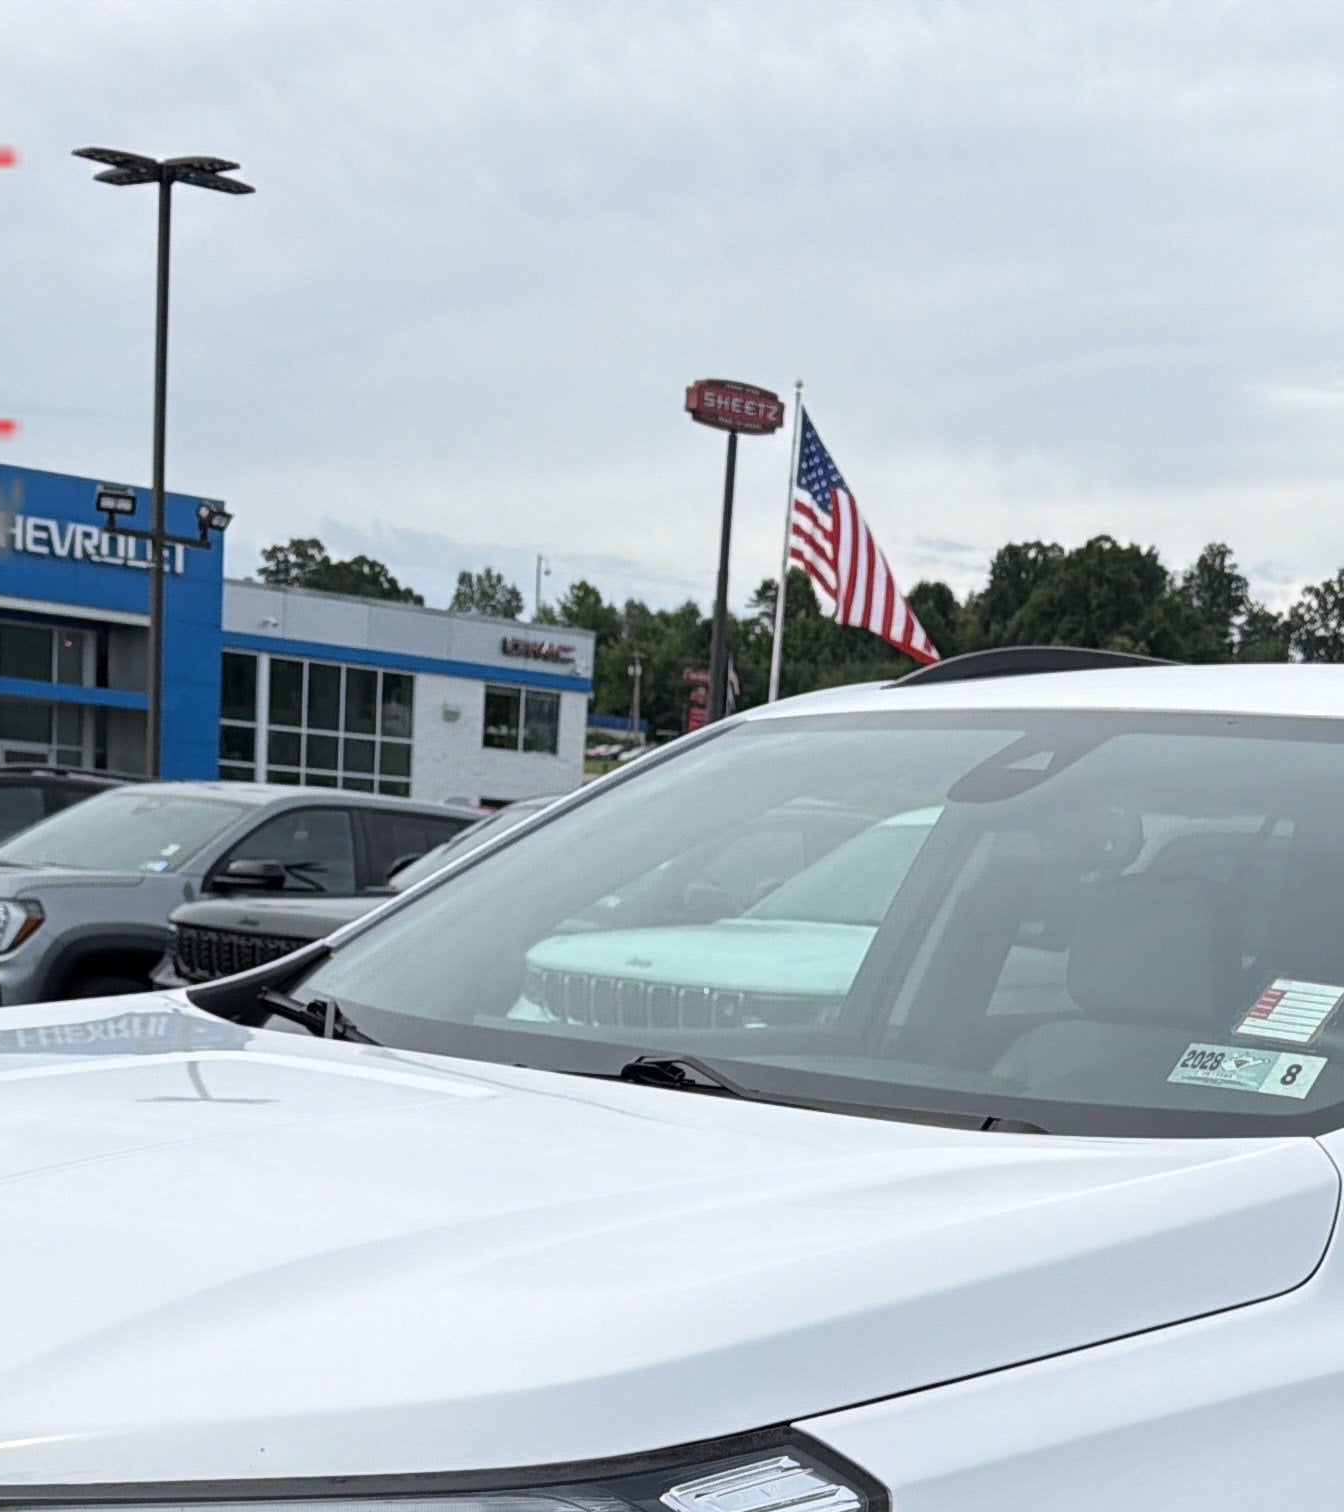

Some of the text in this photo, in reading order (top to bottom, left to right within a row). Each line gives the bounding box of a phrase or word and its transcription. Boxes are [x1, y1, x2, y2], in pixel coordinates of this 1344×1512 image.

[702, 391, 779, 421] SHEETZ
[1179, 1049, 1303, 1086] 2028 8
